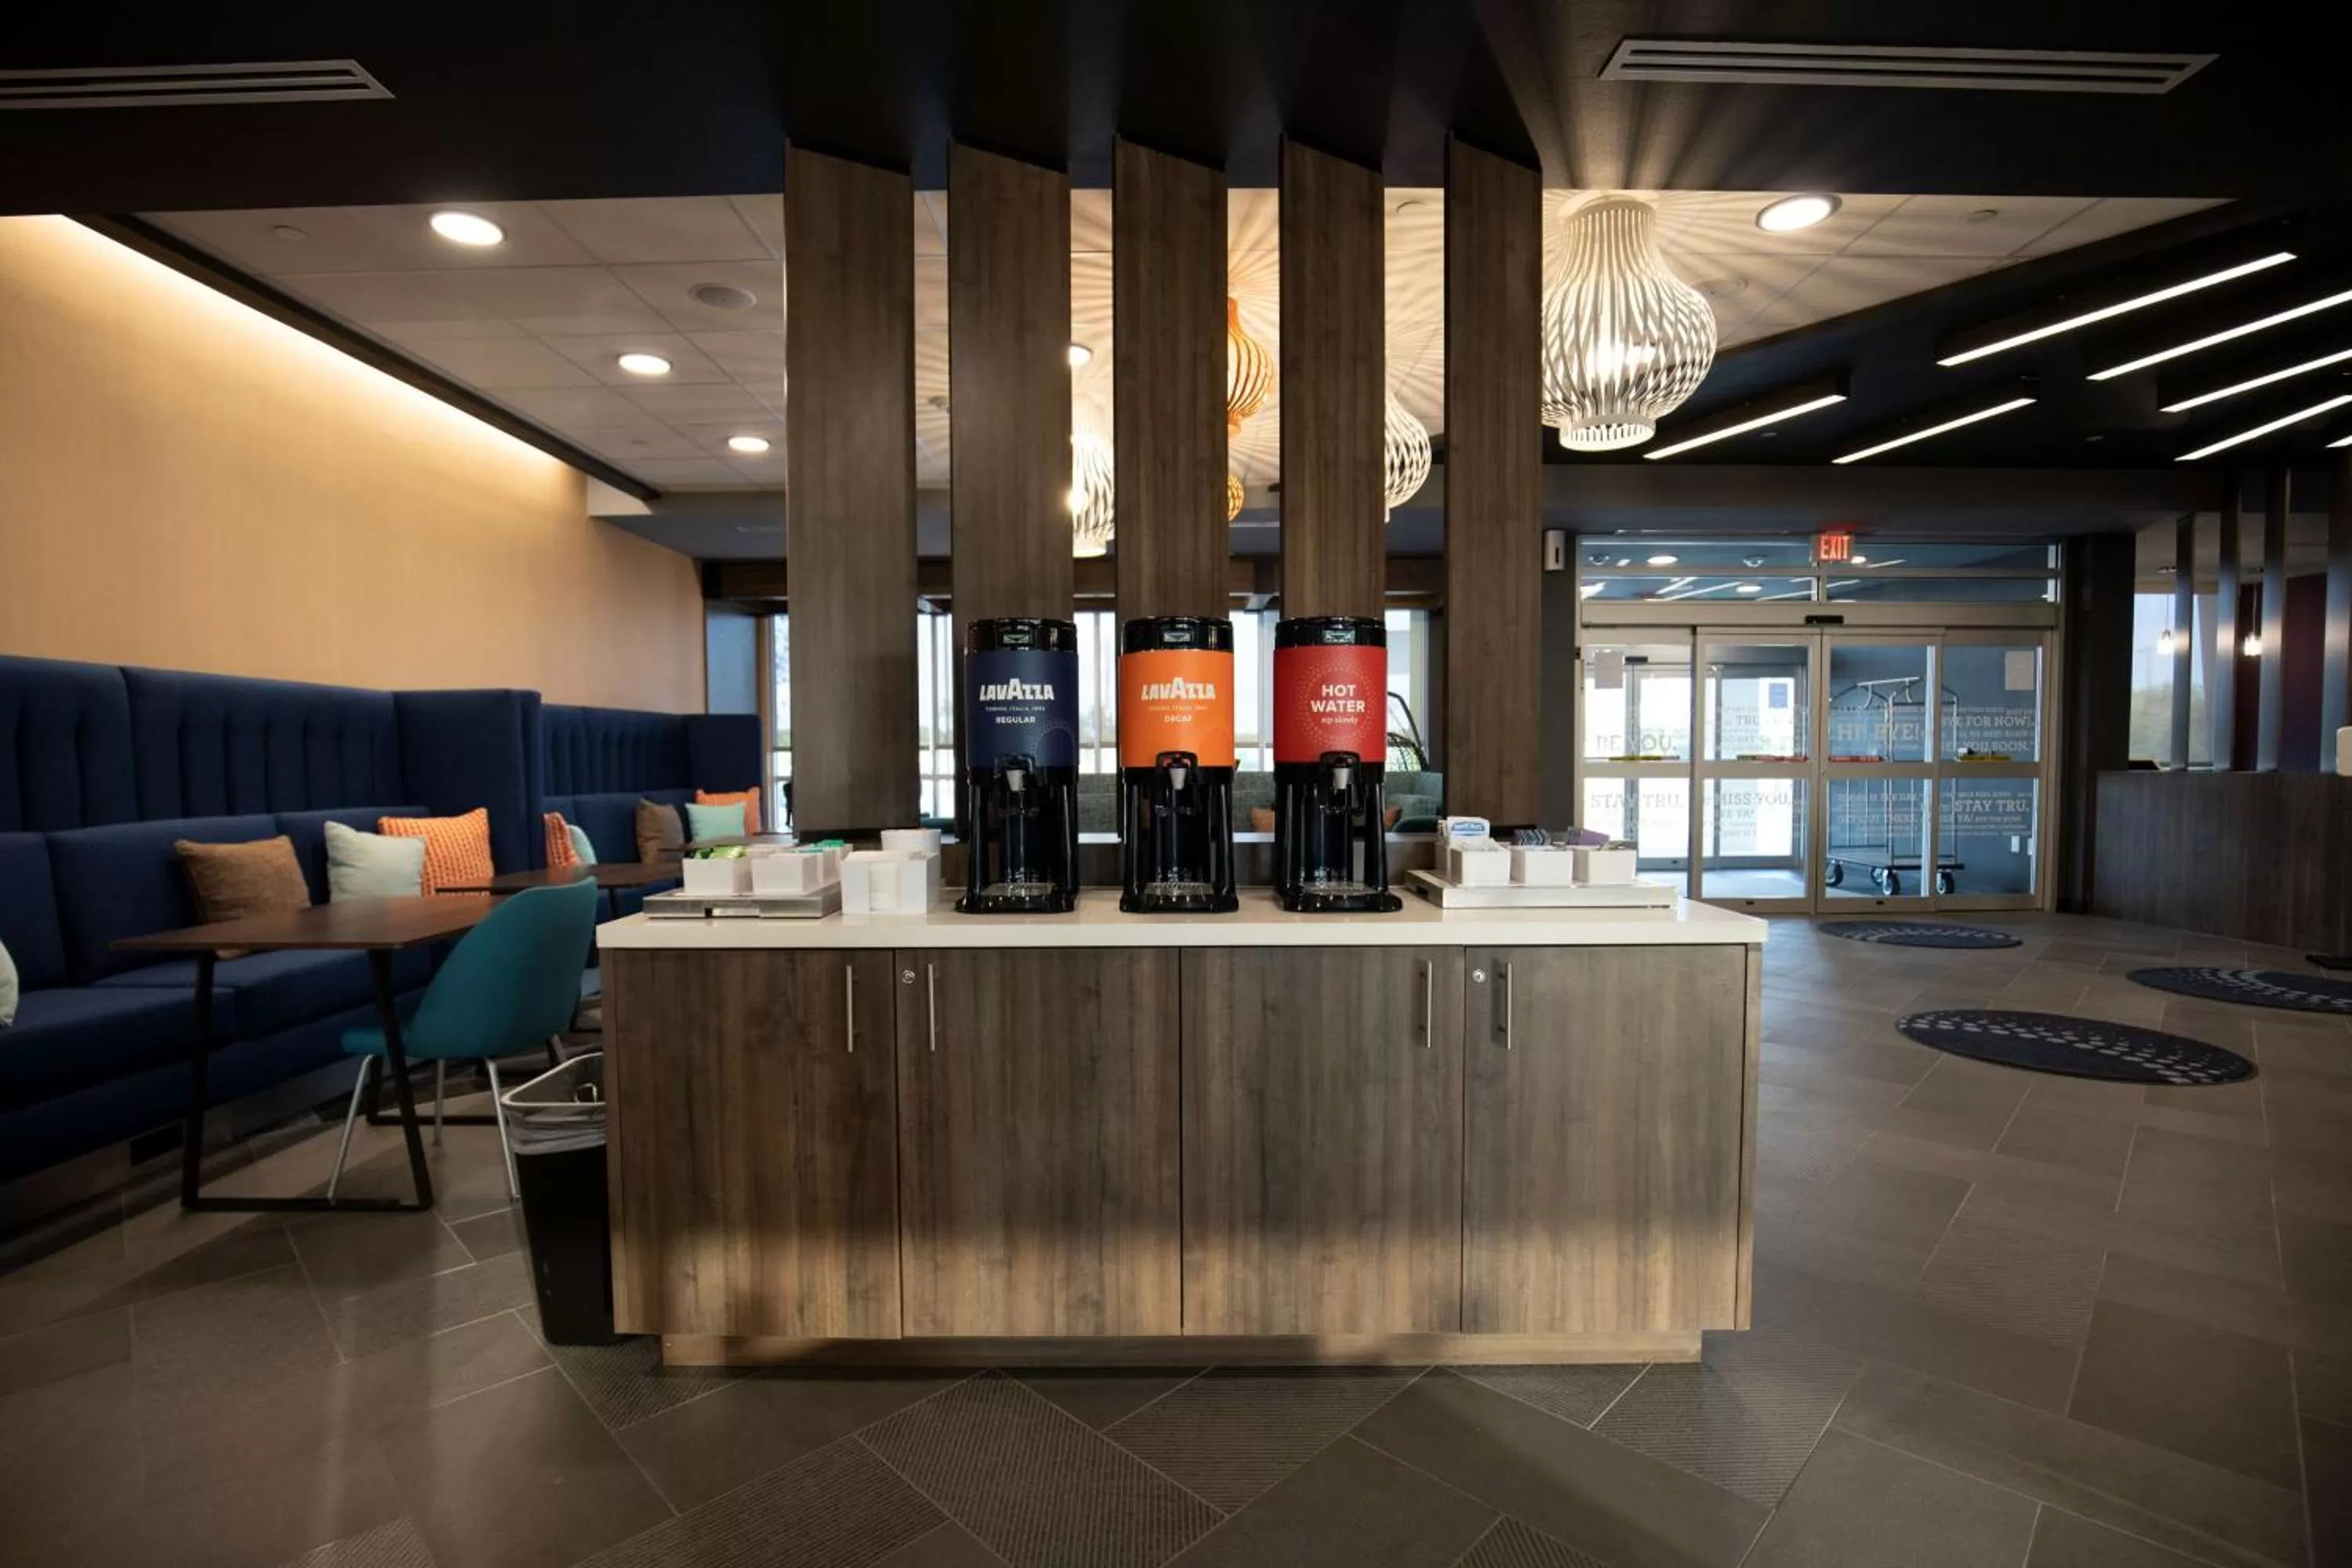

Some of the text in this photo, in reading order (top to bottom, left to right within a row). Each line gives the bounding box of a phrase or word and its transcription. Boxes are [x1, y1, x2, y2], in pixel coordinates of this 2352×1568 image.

[1820, 535, 1850, 561] EXIT
[979, 677, 1054, 701] LAVAZZA
[1141, 677, 1217, 700] LAVAZZA
[1321, 684, 1356, 697] HOT
[1310, 700, 1365, 713] WATER
[1955, 799, 1992, 812] STAY
